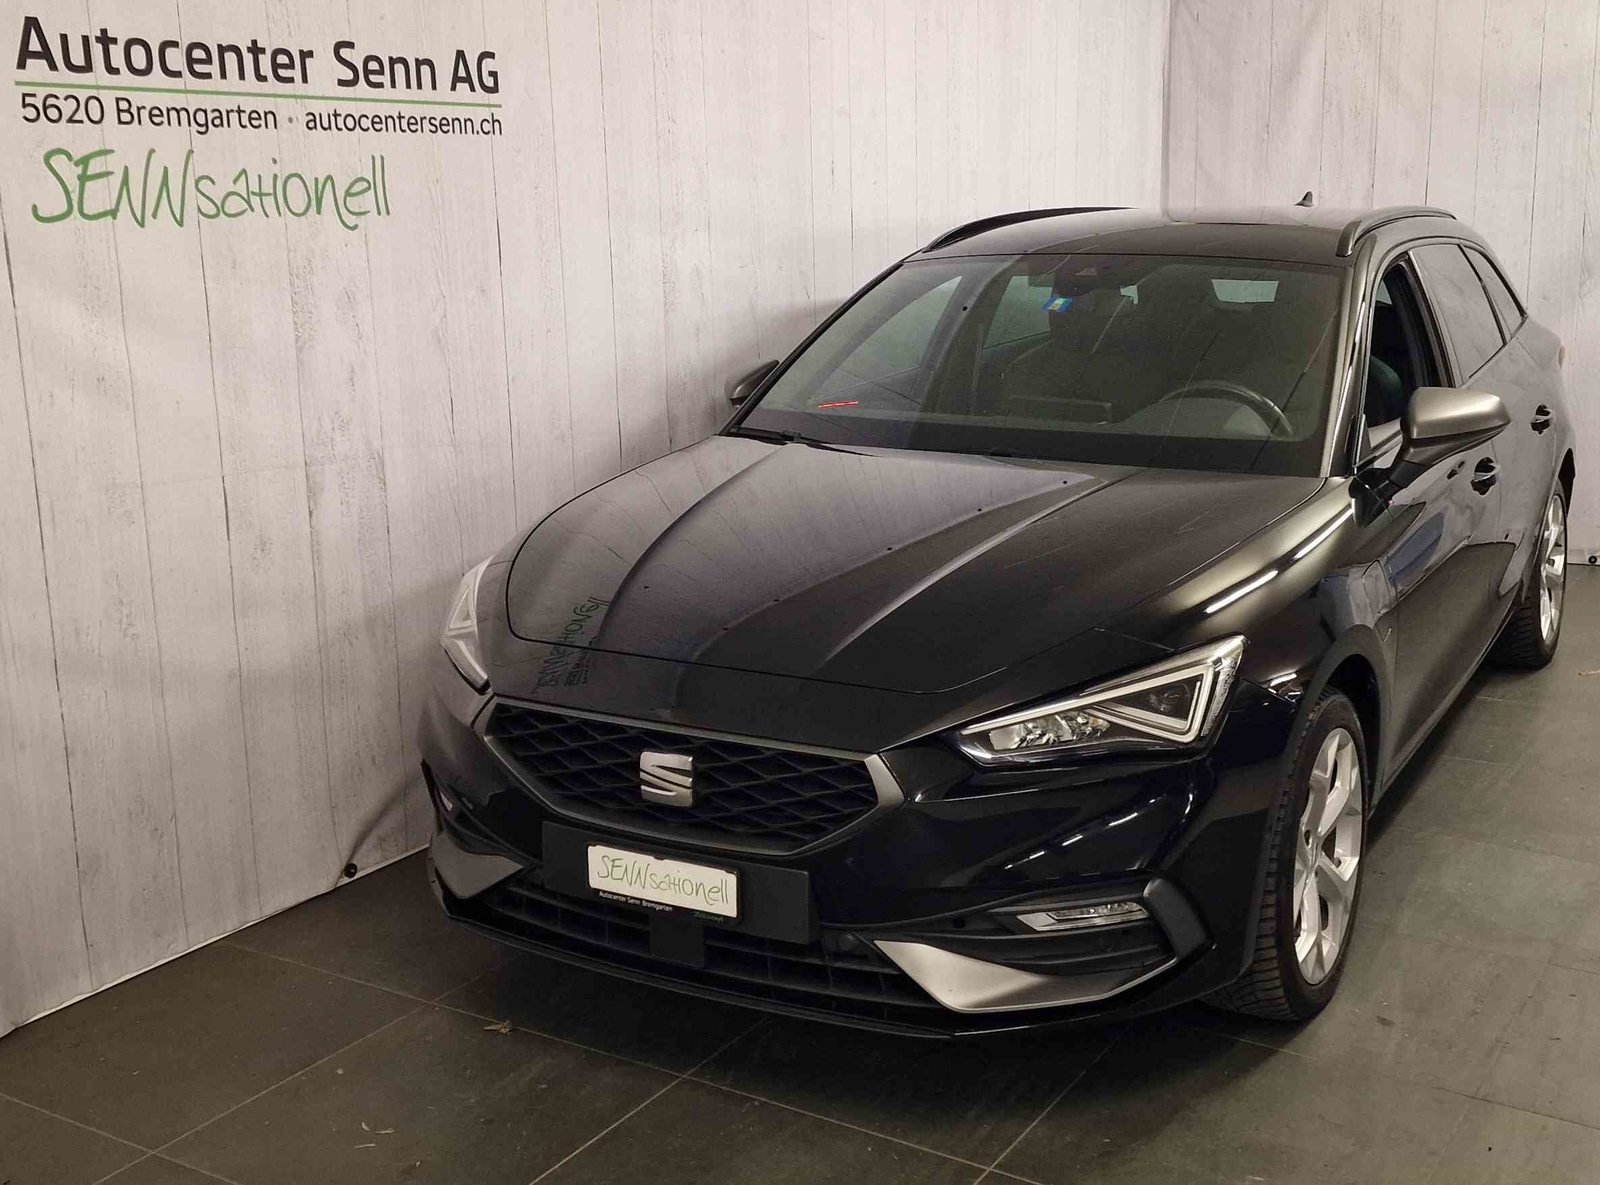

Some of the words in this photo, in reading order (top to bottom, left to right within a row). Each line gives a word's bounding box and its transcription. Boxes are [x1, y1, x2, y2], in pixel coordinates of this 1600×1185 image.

[16, 16, 314, 85] Autocenter
[333, 40, 438, 92] Senn
[450, 49, 500, 95] AG
[21, 92, 105, 125] 5620
[115, 96, 278, 135] Bremgarten
[305, 109, 503, 136] autocentersenn.ch
[31, 148, 391, 231] SENNsationell
[597, 854, 729, 906] SENNsationell
